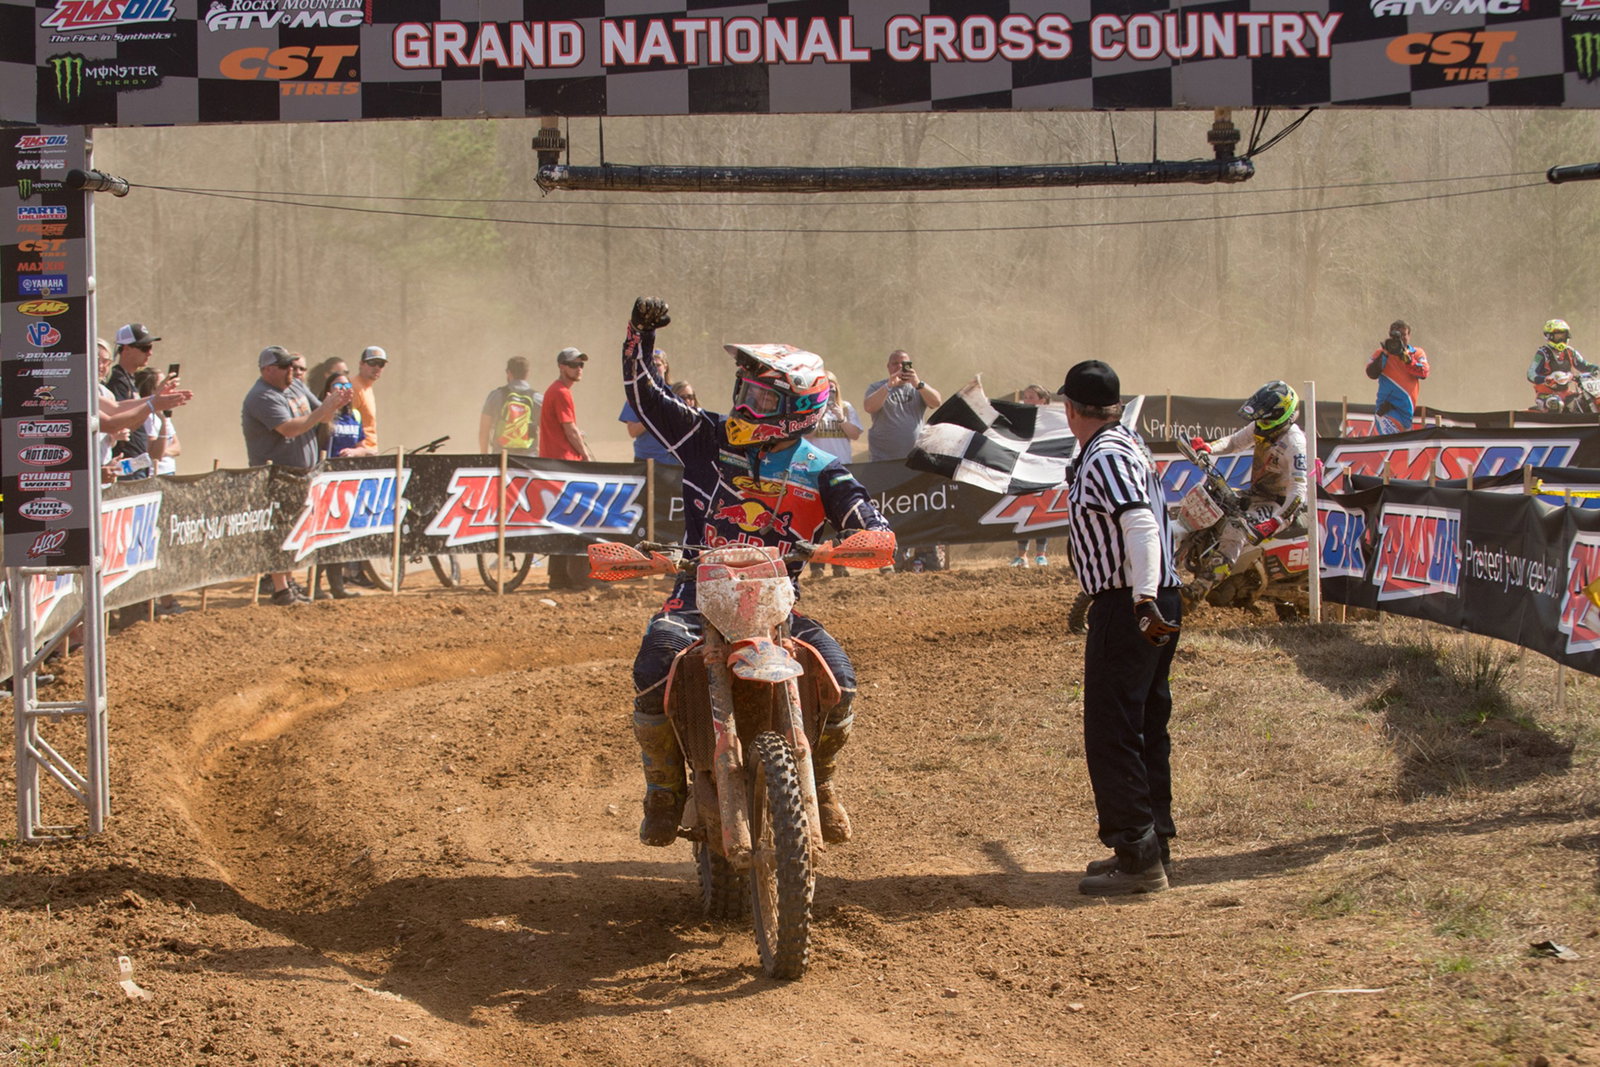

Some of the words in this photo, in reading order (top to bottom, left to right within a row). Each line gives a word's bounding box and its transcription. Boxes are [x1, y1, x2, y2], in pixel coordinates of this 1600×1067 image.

[43, 0, 175, 29] AMSOIL
[72, 34, 98, 42] First
[113, 32, 171, 43] Synthetics
[393, 20, 585, 70] GRAND
[601, 16, 873, 66] NATIONAL
[885, 14, 1074, 63] CROSS
[1089, 12, 1344, 61] COUNTRY
[1386, 31, 1518, 65] CST
[219, 45, 359, 80] CST
[1443, 67, 1519, 81] TIRES
[280, 81, 359, 95] TIRES
[16, 134, 68, 150] AMSOIL
[18, 206, 66, 214] PARTS
[18, 239, 67, 252] CST
[32, 279, 64, 287] YAMAHA
[19, 302, 69, 313] FMF
[27, 322, 51, 346] VP
[20, 472, 71, 480] CYLINDER
[430, 472, 641, 542] AMSOIL
[705, 523, 747, 549] Red
[1374, 509, 1461, 597] AMSOIL
